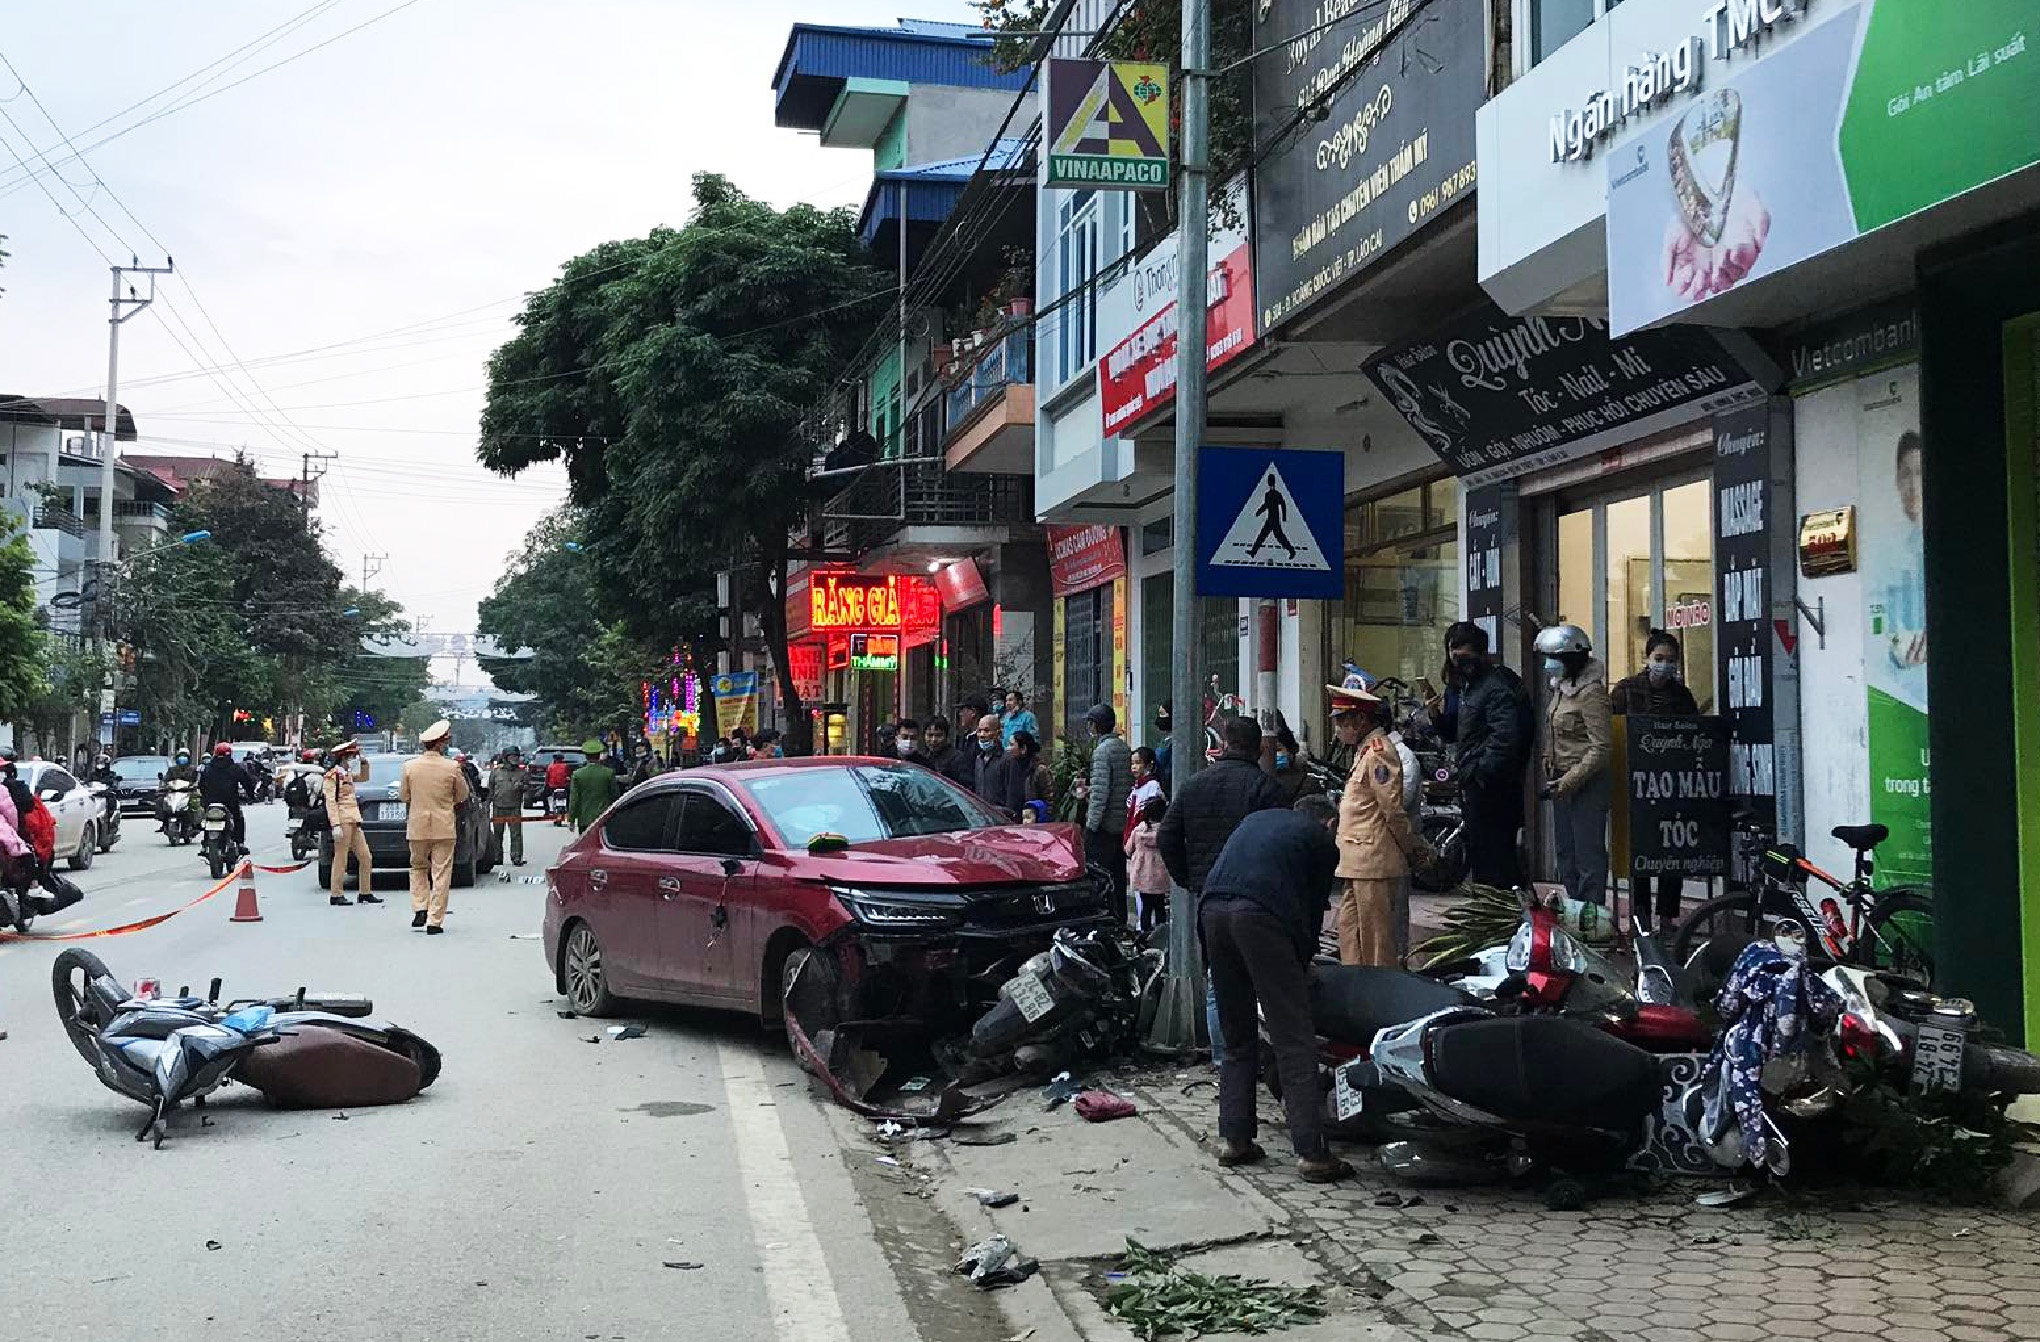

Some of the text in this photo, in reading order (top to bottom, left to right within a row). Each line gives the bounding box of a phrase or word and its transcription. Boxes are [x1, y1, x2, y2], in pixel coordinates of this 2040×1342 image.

[1550, 91, 1614, 162] Ngân
[1622, 36, 1703, 117] hàng
[1913, 85, 1932, 104] An
[1935, 72, 1964, 93] tâm
[1055, 159, 1162, 182] VINAAPACO
[1511, 424, 1561, 452] NHUỘM
[1624, 377, 1692, 413] CHUYÊN
[1684, 364, 1727, 390] SÂU
[1517, 387, 1558, 415] Tóc
[1558, 364, 1610, 401] Nail
[812, 577, 864, 627] RĂNG
[1633, 756, 1722, 806] TẠO MẪU
[1885, 776, 1919, 798] trong
[1659, 811, 1699, 849] TÓC
[1634, 855, 1681, 874] Chuyên
